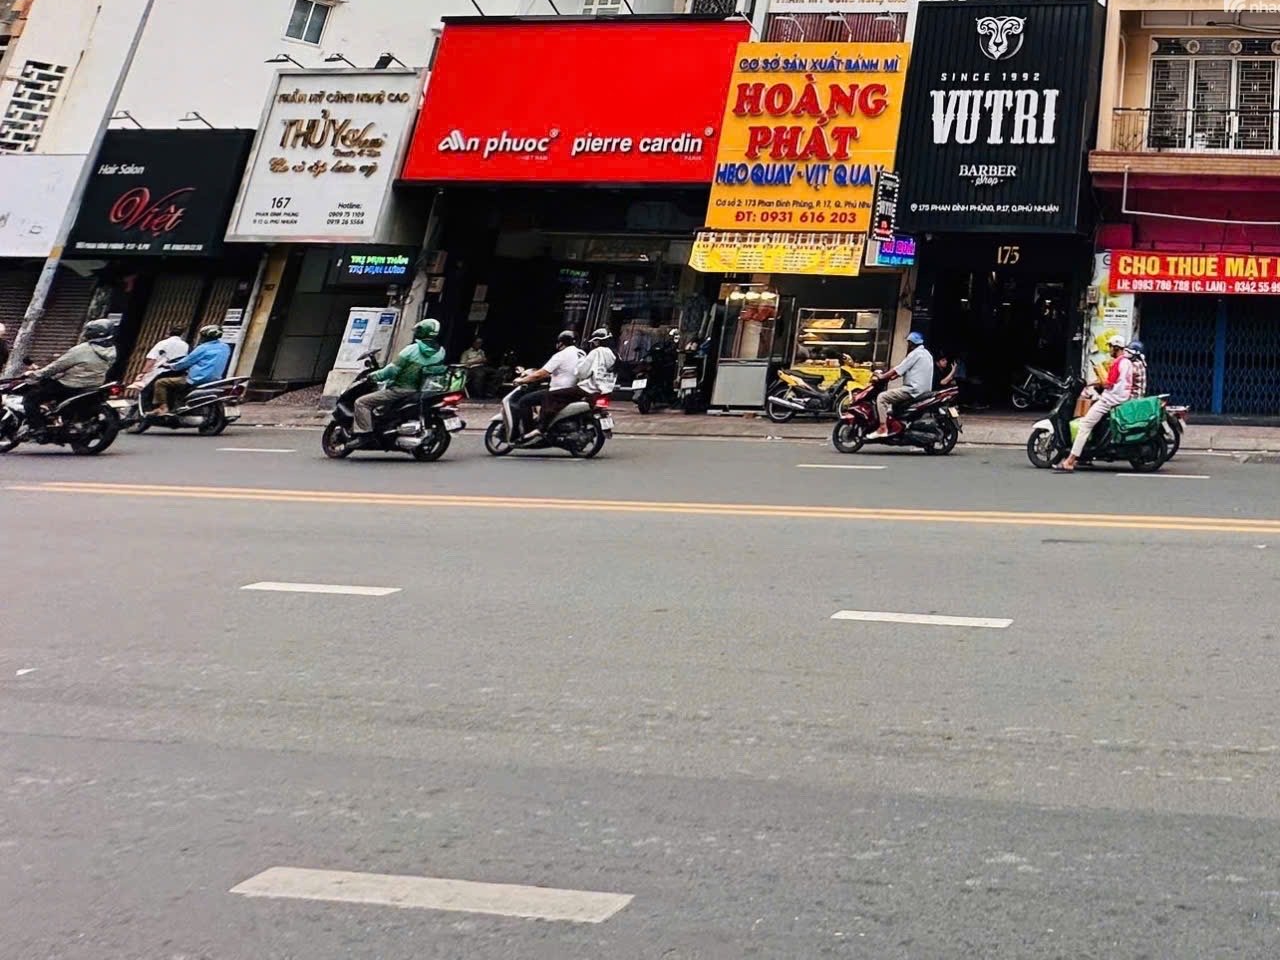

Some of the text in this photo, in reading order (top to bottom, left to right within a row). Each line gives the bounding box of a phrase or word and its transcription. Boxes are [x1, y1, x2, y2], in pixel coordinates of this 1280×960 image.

[809, 51, 843, 71] XUẤT
[844, 53, 879, 72] BÁNH
[883, 54, 900, 72] MÌ
[940, 73, 1041, 82] SINCE 1992
[387, 92, 410, 103] CAO
[732, 72, 889, 118] HOÀNG
[930, 88, 1060, 145] VUTRI
[483, 130, 549, 158] phuoc
[571, 131, 703, 156] pierre cardin
[744, 114, 861, 162] PHÁT
[98, 164, 145, 175] Hair Salon
[750, 163, 795, 187] QUAY
[959, 164, 1017, 177] BARBER
[109, 187, 196, 236] Việt
[271, 197, 291, 209] 167
[757, 200, 775, 208] Phan
[930, 204, 950, 212] PHAN
[735, 211, 857, 223] ĐT: 0931 616 203
[997, 246, 1020, 264] 175
[1118, 255, 1160, 275] CHO
[1167, 256, 1218, 276] THUÊ
[1224, 257, 1270, 280] MẶT
[1205, 282, 1226, 292] LAN)
